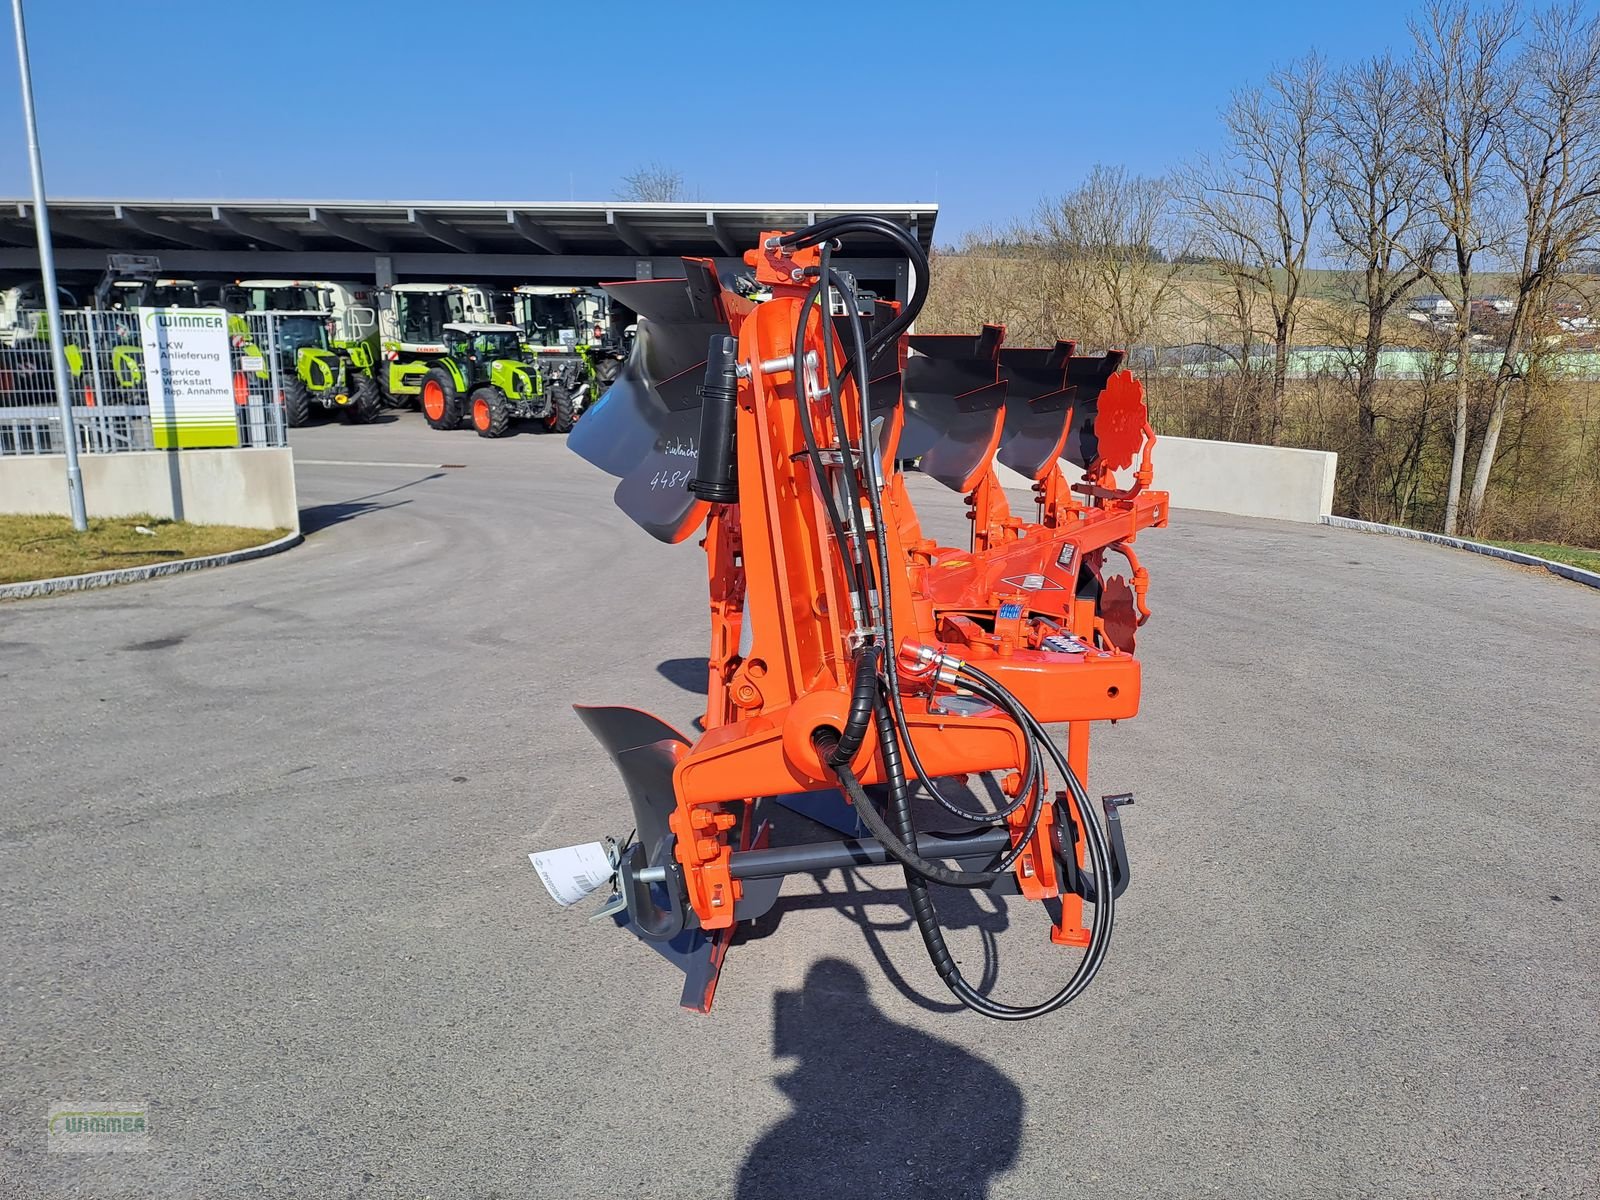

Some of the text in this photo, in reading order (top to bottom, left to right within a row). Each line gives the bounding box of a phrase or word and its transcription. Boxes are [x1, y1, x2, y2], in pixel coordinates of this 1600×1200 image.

[158, 315, 223, 328] WIMMER
[159, 341, 183, 350] LKW
[160, 351, 220, 361] Anlieferung
[161, 368, 200, 376] Service
[162, 378, 212, 386] Werkstatt
[164, 387, 229, 396] Rep. Annahme
[650, 470, 691, 491] 4481
